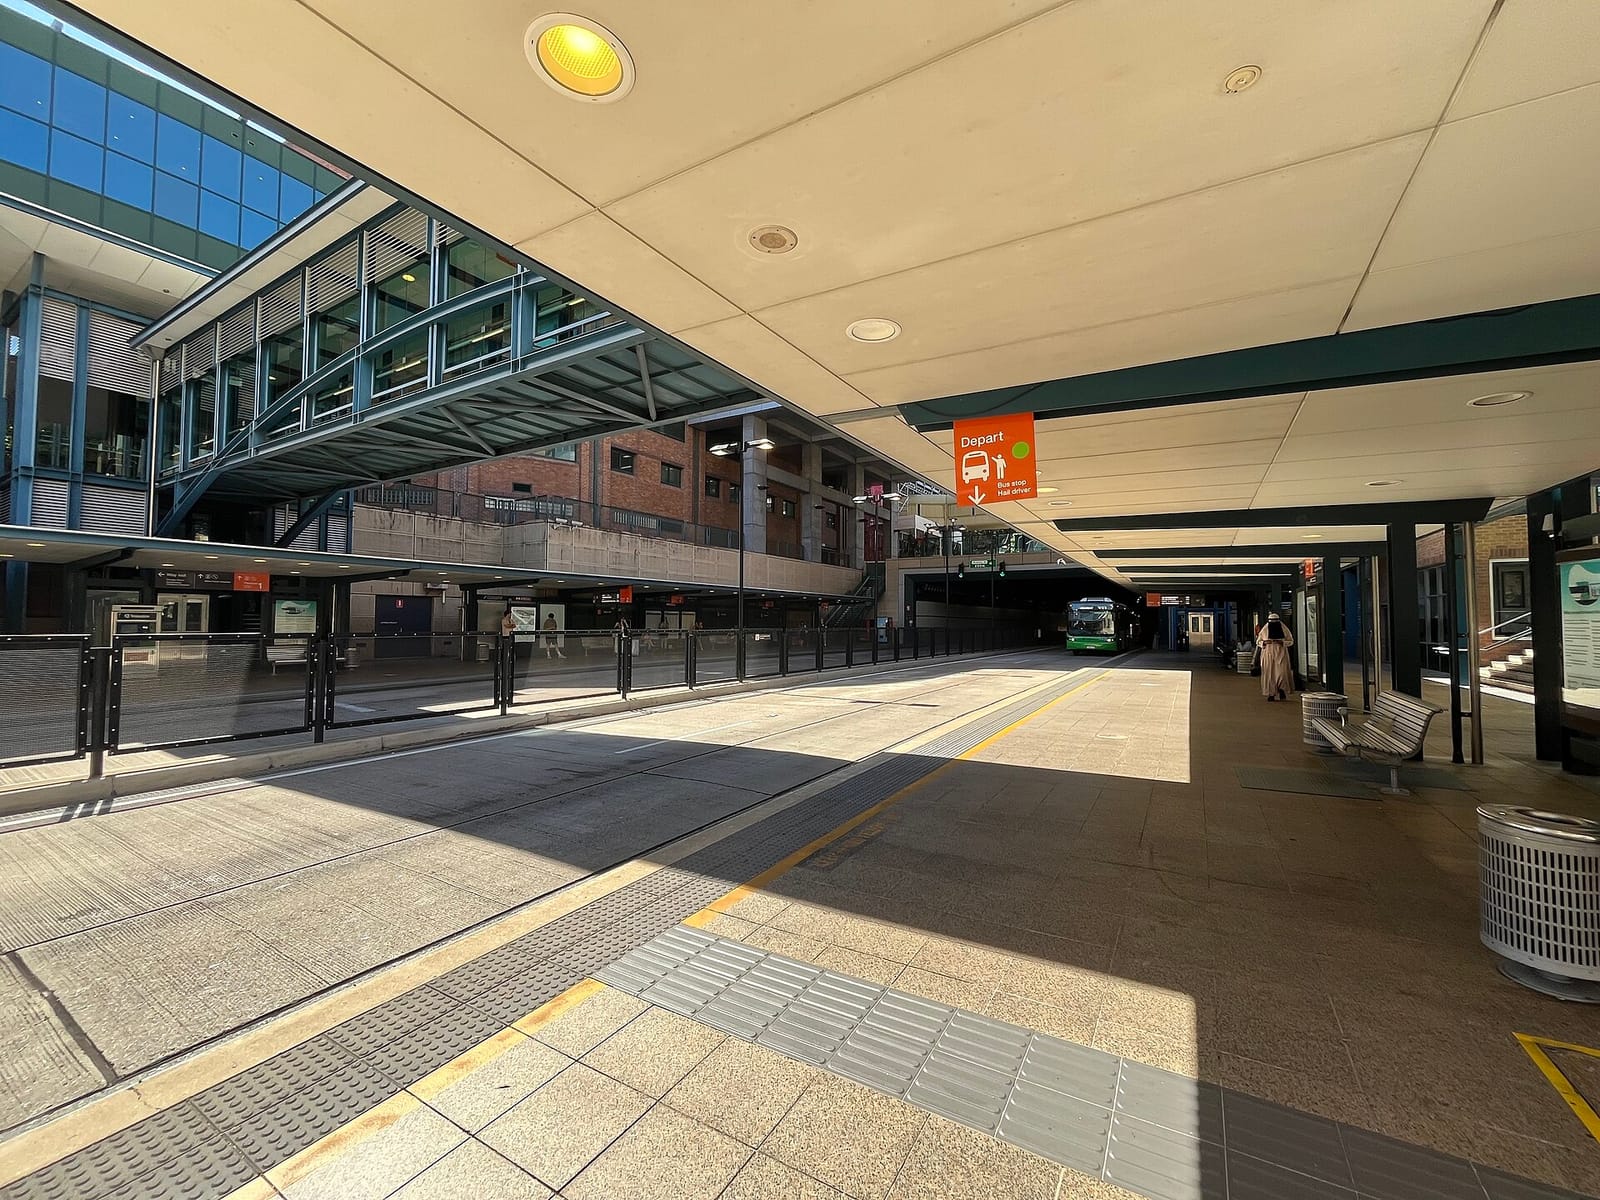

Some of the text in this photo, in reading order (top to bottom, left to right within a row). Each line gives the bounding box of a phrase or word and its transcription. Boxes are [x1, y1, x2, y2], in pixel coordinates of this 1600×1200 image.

[961, 431, 1004, 448] Depart
[997, 481, 1010, 489] Bus
[997, 487, 1031, 497] Hail driver
